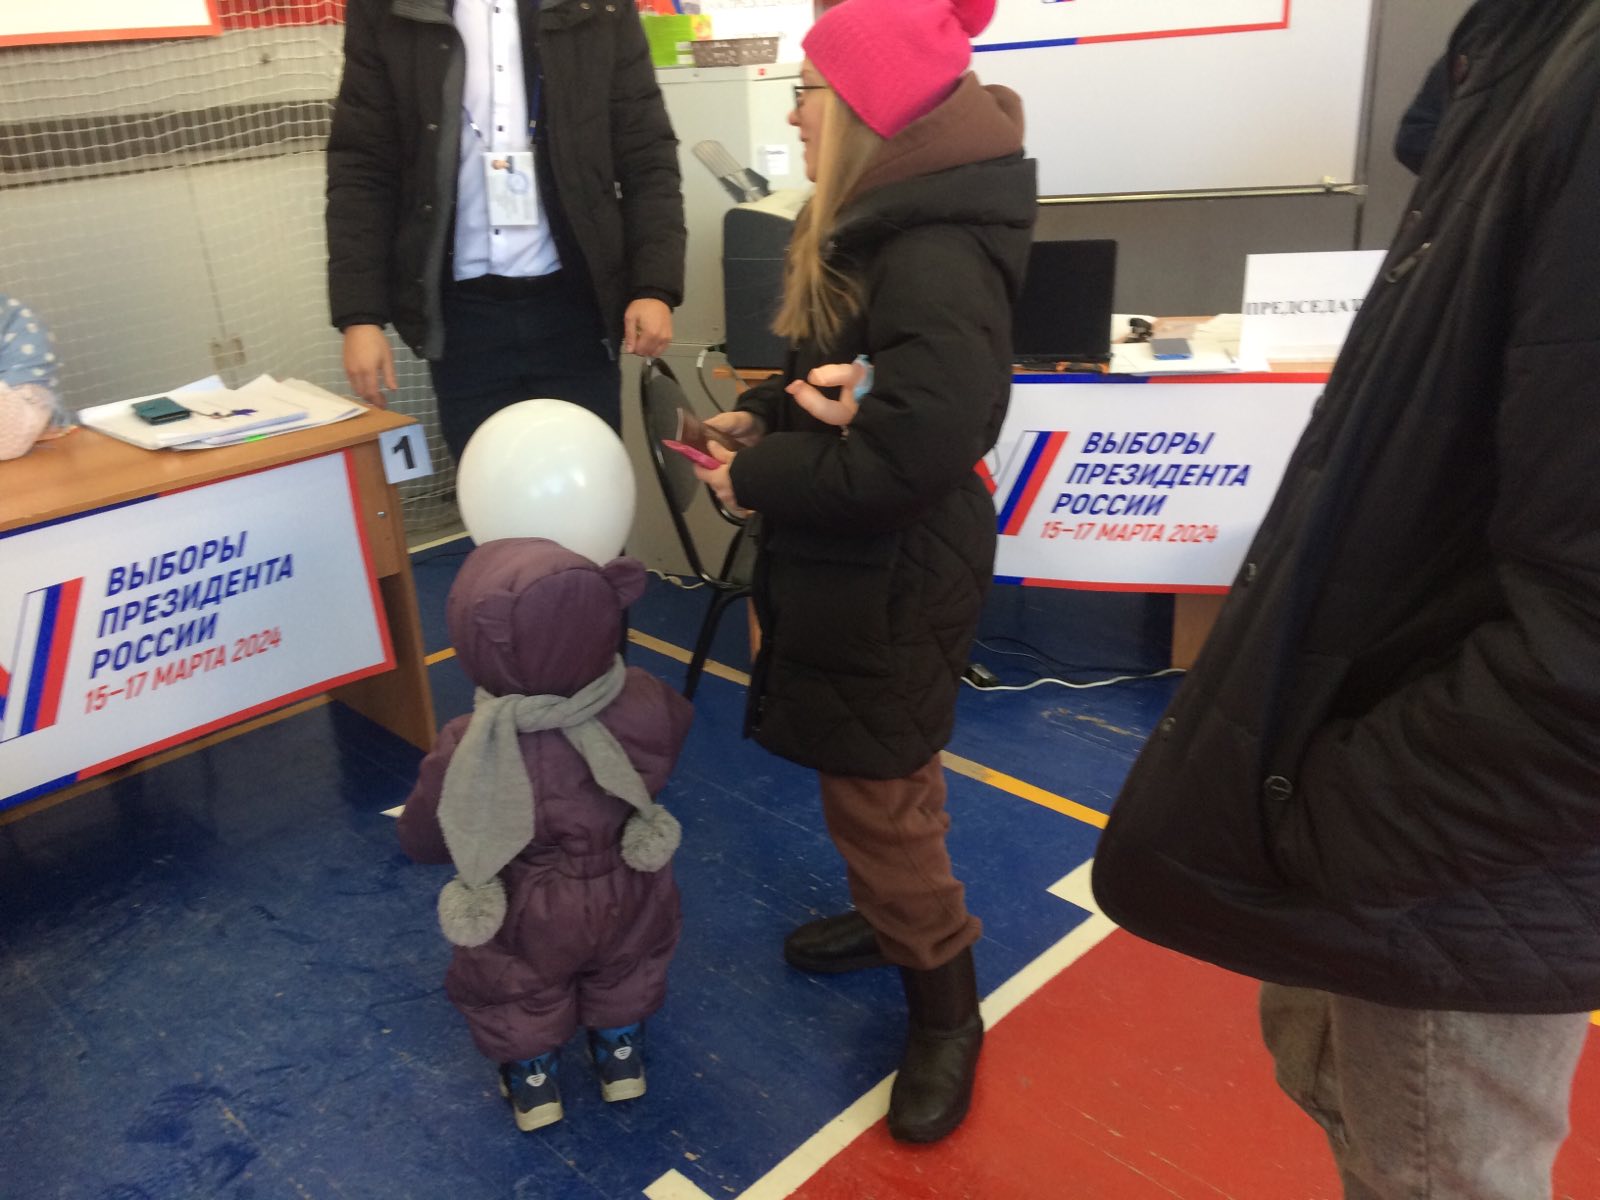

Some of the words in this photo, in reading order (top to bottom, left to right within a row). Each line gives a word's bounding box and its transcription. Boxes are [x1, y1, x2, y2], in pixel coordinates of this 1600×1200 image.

[392, 434, 416, 470] 1
[1081, 431, 1217, 455] ВЫБОРЫ
[1065, 462, 1253, 489] ПРЕЗИДЕНТА
[1051, 492, 1169, 516] РОССИИ
[1094, 523, 1166, 542] МАРТА
[1168, 524, 1219, 543] 2024
[105, 530, 248, 597] ВЫБОРЫ
[96, 553, 295, 638] ПРЕЗИДЕНТА
[89, 612, 219, 679] РОССИИ
[151, 644, 227, 690] МАРТА
[230, 626, 283, 663] 2024
